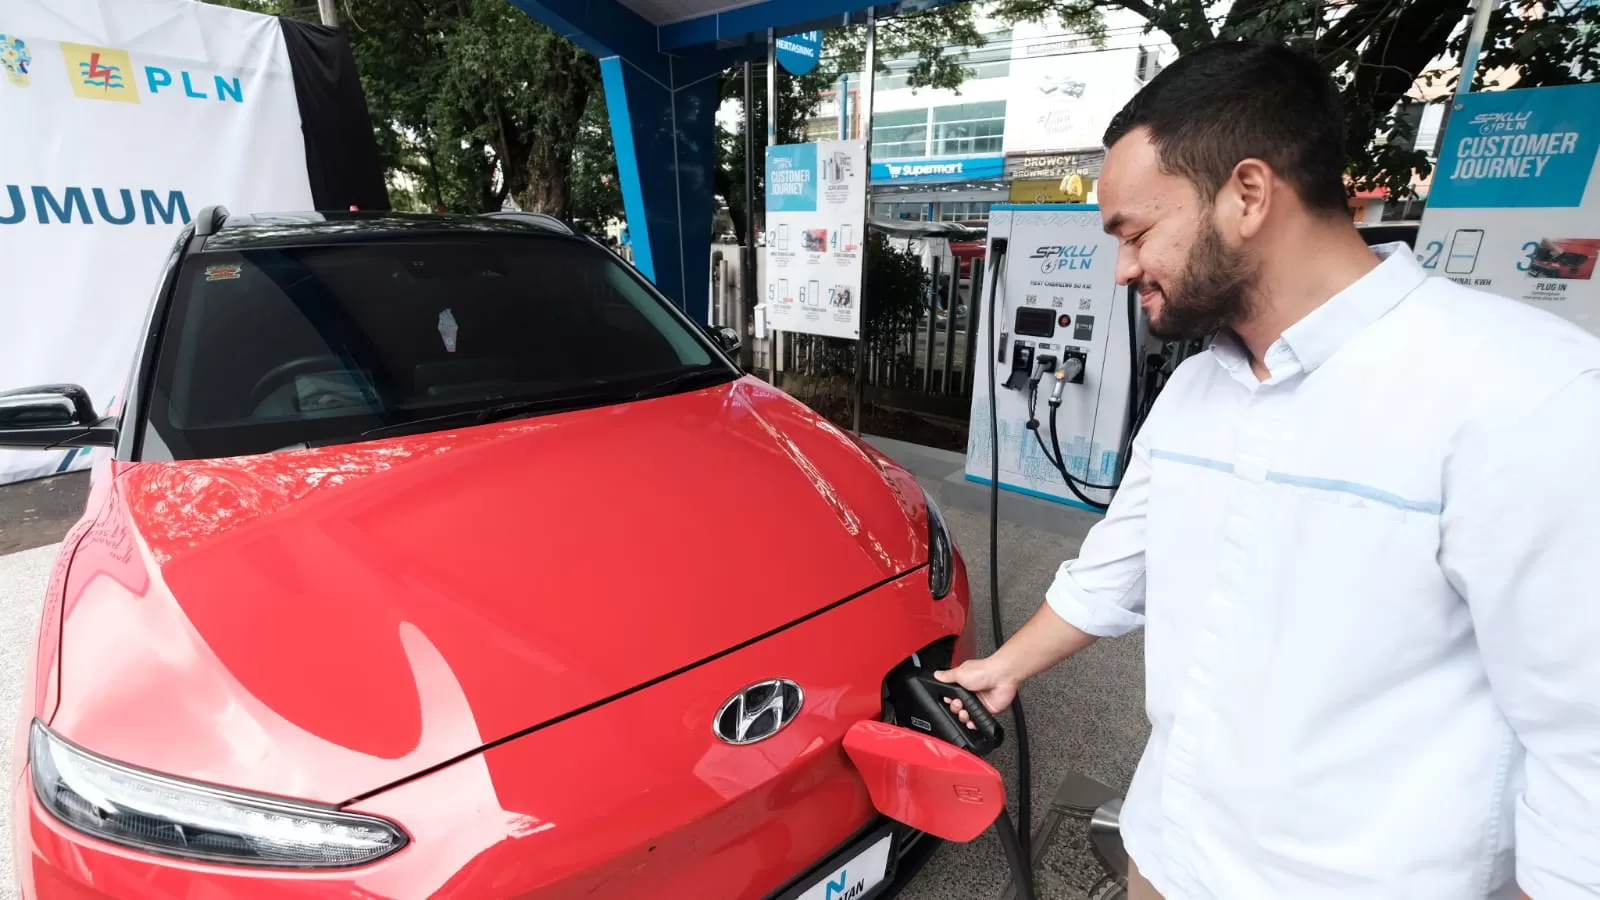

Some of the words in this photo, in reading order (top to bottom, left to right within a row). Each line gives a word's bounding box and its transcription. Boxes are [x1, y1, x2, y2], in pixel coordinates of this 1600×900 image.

[144, 65, 244, 103] PLN
[1468, 110, 1533, 125] SPKLU
[1495, 120, 1527, 132] PLN
[1457, 132, 1579, 158] CUSTOMER
[1450, 155, 1551, 180] JOURNEY
[770, 169, 811, 183] CUSTOMER
[771, 182, 804, 196] JOURNEY
[0, 184, 191, 226] UMUM
[1029, 245, 1098, 258] SPKLU
[1422, 241, 1444, 269] 2
[1516, 241, 1540, 272] 3
[1058, 259, 1092, 269] PLN
[1447, 276, 1473, 287] MINAL
[1536, 282, 1557, 292] PLUG
[1557, 283, 1568, 292] IN
